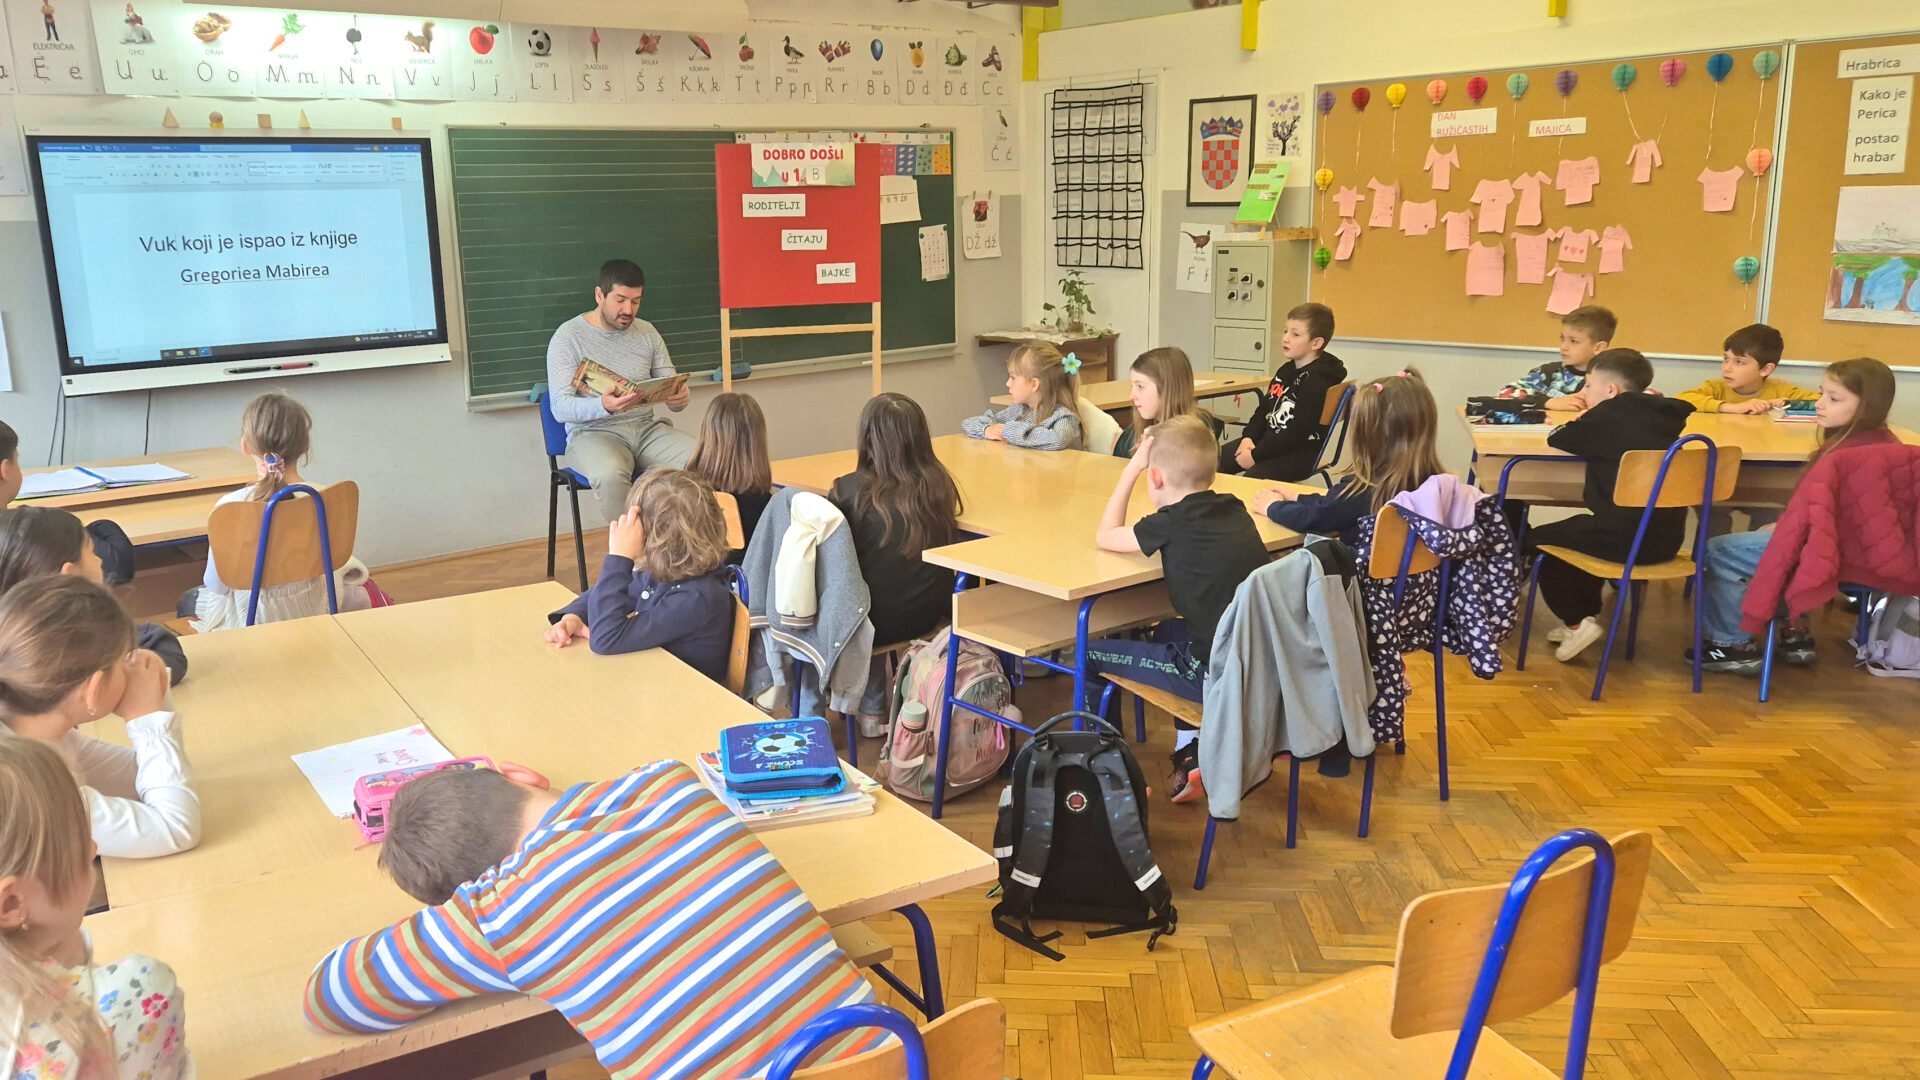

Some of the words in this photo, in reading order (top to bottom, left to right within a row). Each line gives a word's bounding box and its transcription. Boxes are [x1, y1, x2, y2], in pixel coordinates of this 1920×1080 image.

[33, 42, 74, 50] ELEKTRIČAR
[34, 56, 50, 80] E
[69, 65, 83, 80] e
[116, 59, 133, 80] U
[152, 68, 168, 81] u
[1846, 58, 1901, 71] Hrabrica
[197, 62, 213, 81] O
[228, 69, 239, 83] o
[266, 64, 290, 83] M
[298, 71, 318, 84] m
[339, 66, 355, 85] N
[367, 74, 380, 85] n
[404, 68, 416, 86] V
[431, 76, 440, 86] v
[637, 68, 645, 92] Š
[656, 76, 664, 92] š
[470, 71, 476, 91] J
[494, 74, 499, 96] j
[530, 72, 541, 90] L
[583, 73, 592, 91] S
[604, 81, 611, 92] s
[681, 76, 691, 92] K
[697, 76, 707, 94] k
[735, 75, 744, 91] T
[755, 80, 760, 93] t
[775, 76, 783, 92] P
[790, 82, 797, 99] p
[825, 78, 834, 93] R
[842, 83, 848, 92] r
[867, 80, 874, 95] B
[884, 80, 890, 95] b
[907, 80, 914, 95] D
[923, 81, 930, 95] d
[944, 81, 952, 95] Đ
[982, 81, 990, 95] C
[997, 86, 1003, 95] c
[1860, 89, 1891, 101] Kako
[1894, 88, 1907, 101] je
[1437, 112, 1457, 121] DAN
[1857, 109, 1897, 119] Perica
[1436, 124, 1488, 137] RUŽIČASTIH
[1535, 123, 1572, 135] MAJICA
[1855, 134, 1900, 147] postao
[763, 149, 805, 160] DOBRO
[810, 145, 844, 160] DOŠLI
[1853, 151, 1897, 163] hrabar
[782, 172, 789, 182] u
[793, 168, 804, 182] 1.
[813, 167, 820, 181] B
[748, 201, 801, 210] RODITELJI
[139, 235, 177, 252] Vuk
[182, 234, 213, 254] koji
[218, 234, 234, 253] je
[239, 233, 286, 251] ispao
[291, 232, 305, 247] iz
[310, 230, 358, 249] knjige
[787, 233, 823, 244] ČITAJU
[966, 232, 981, 250] DŽ
[985, 233, 998, 248] dž
[180, 266, 261, 284] Gregoriea
[266, 263, 330, 279] Mabirea
[821, 268, 851, 277] BAJKE
[1187, 266, 1195, 281] F
[1709, 649, 1726, 660] N
